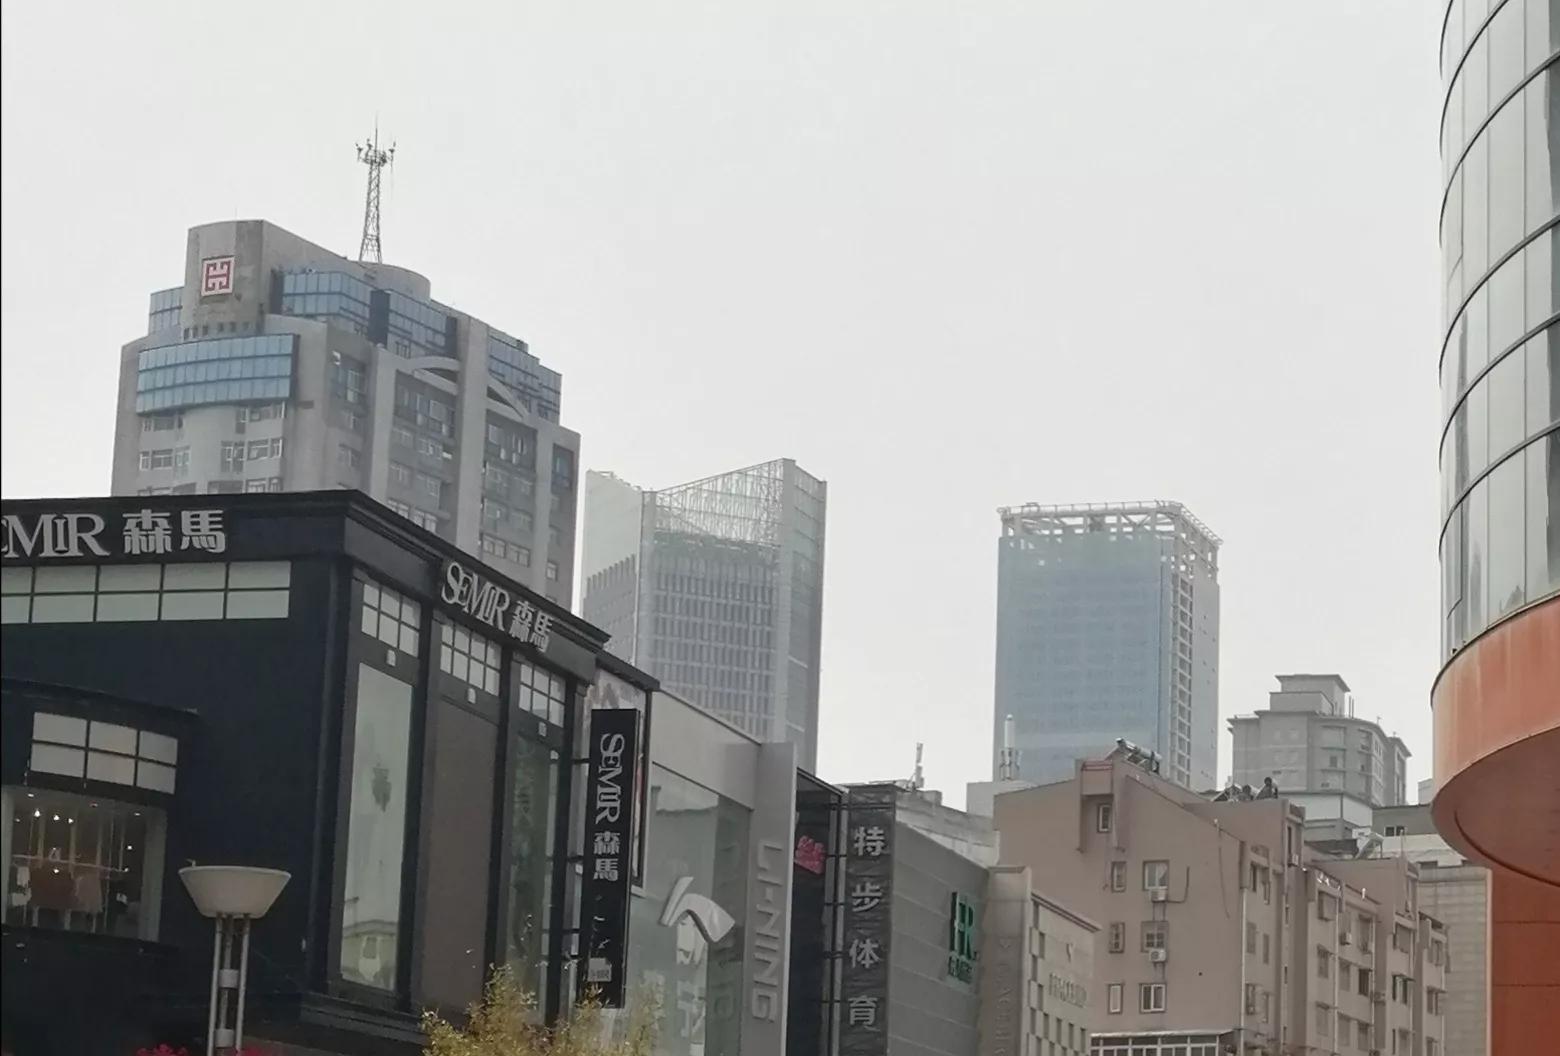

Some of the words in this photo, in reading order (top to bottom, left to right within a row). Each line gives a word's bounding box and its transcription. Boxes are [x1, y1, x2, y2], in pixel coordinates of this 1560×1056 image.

[0, 513, 111, 558] MIR
[122, 509, 226, 554] 森馬
[441, 561, 510, 632] SEMIR
[596, 733, 625, 825] SEMIR
[847, 825, 886, 1033] 特步体育
